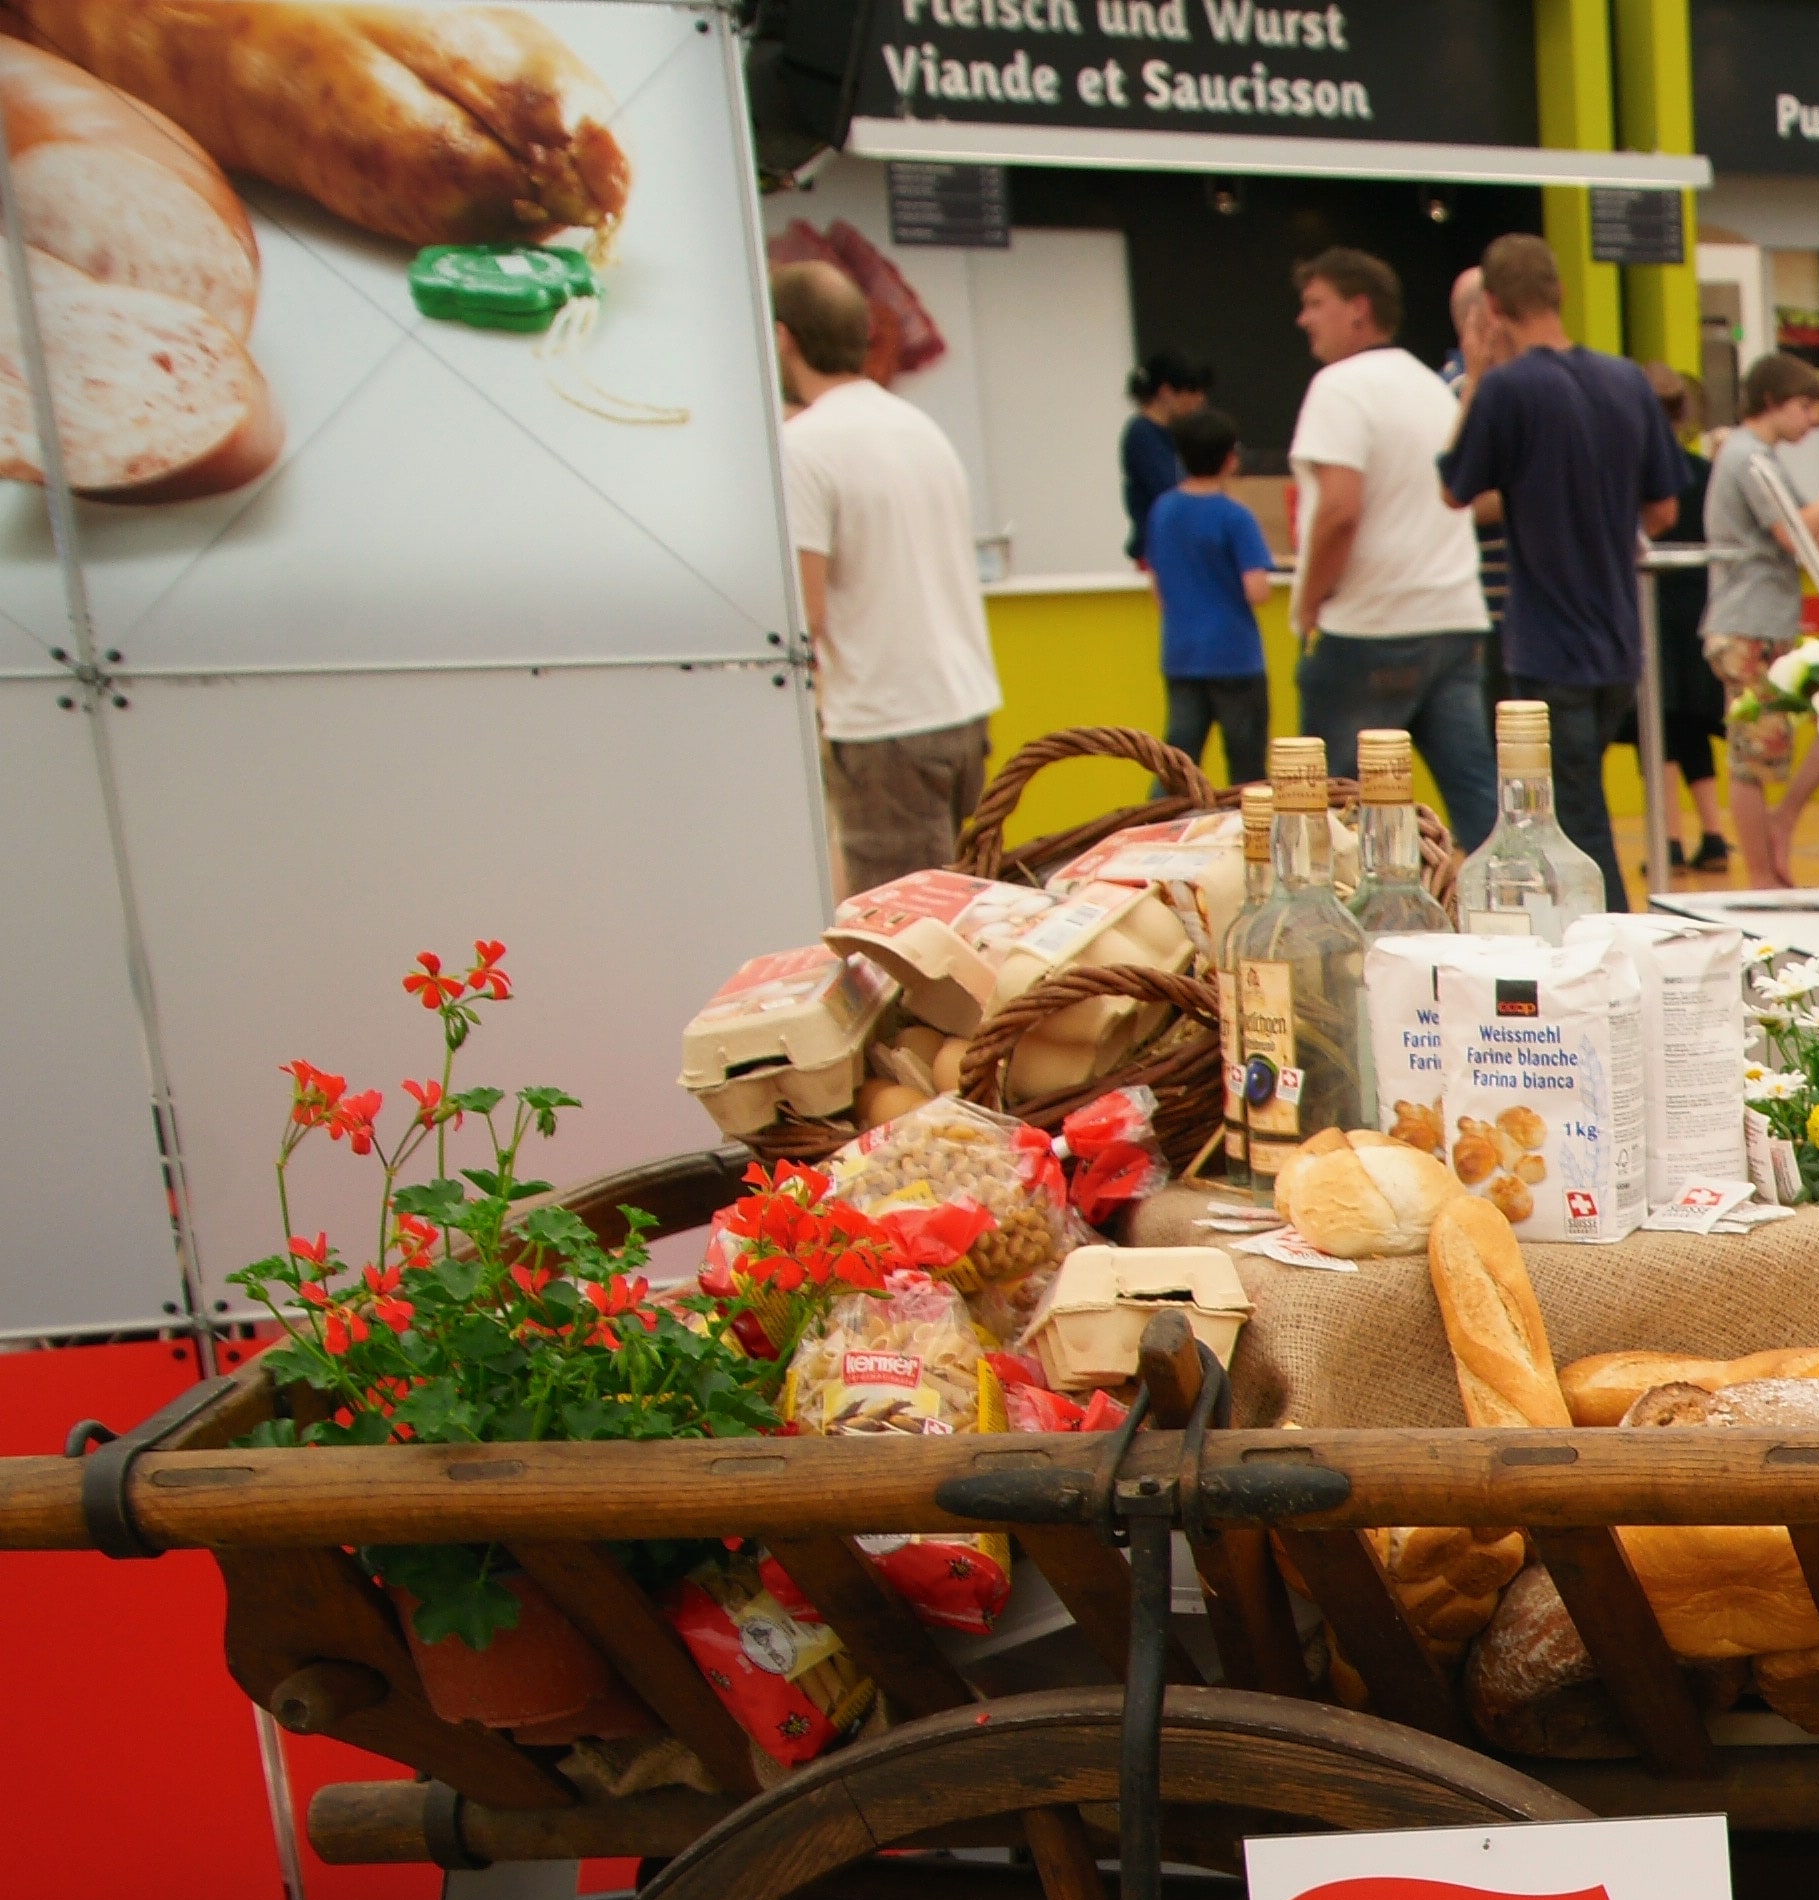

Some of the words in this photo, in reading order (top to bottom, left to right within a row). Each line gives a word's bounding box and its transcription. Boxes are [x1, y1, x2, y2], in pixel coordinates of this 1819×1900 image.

[1100, 0, 1191, 41] und
[1206, 0, 1348, 49] Wurst
[883, 43, 1060, 103] Viande
[1078, 58, 1128, 108] et
[1141, 58, 1372, 119] Saucisson
[1479, 1025, 1560, 1044] Weissmehl
[1467, 1048, 1514, 1066] Farine
[1519, 1049, 1578, 1067] blanche
[1472, 1070, 1516, 1088] Farina
[1522, 1071, 1574, 1089] bianca
